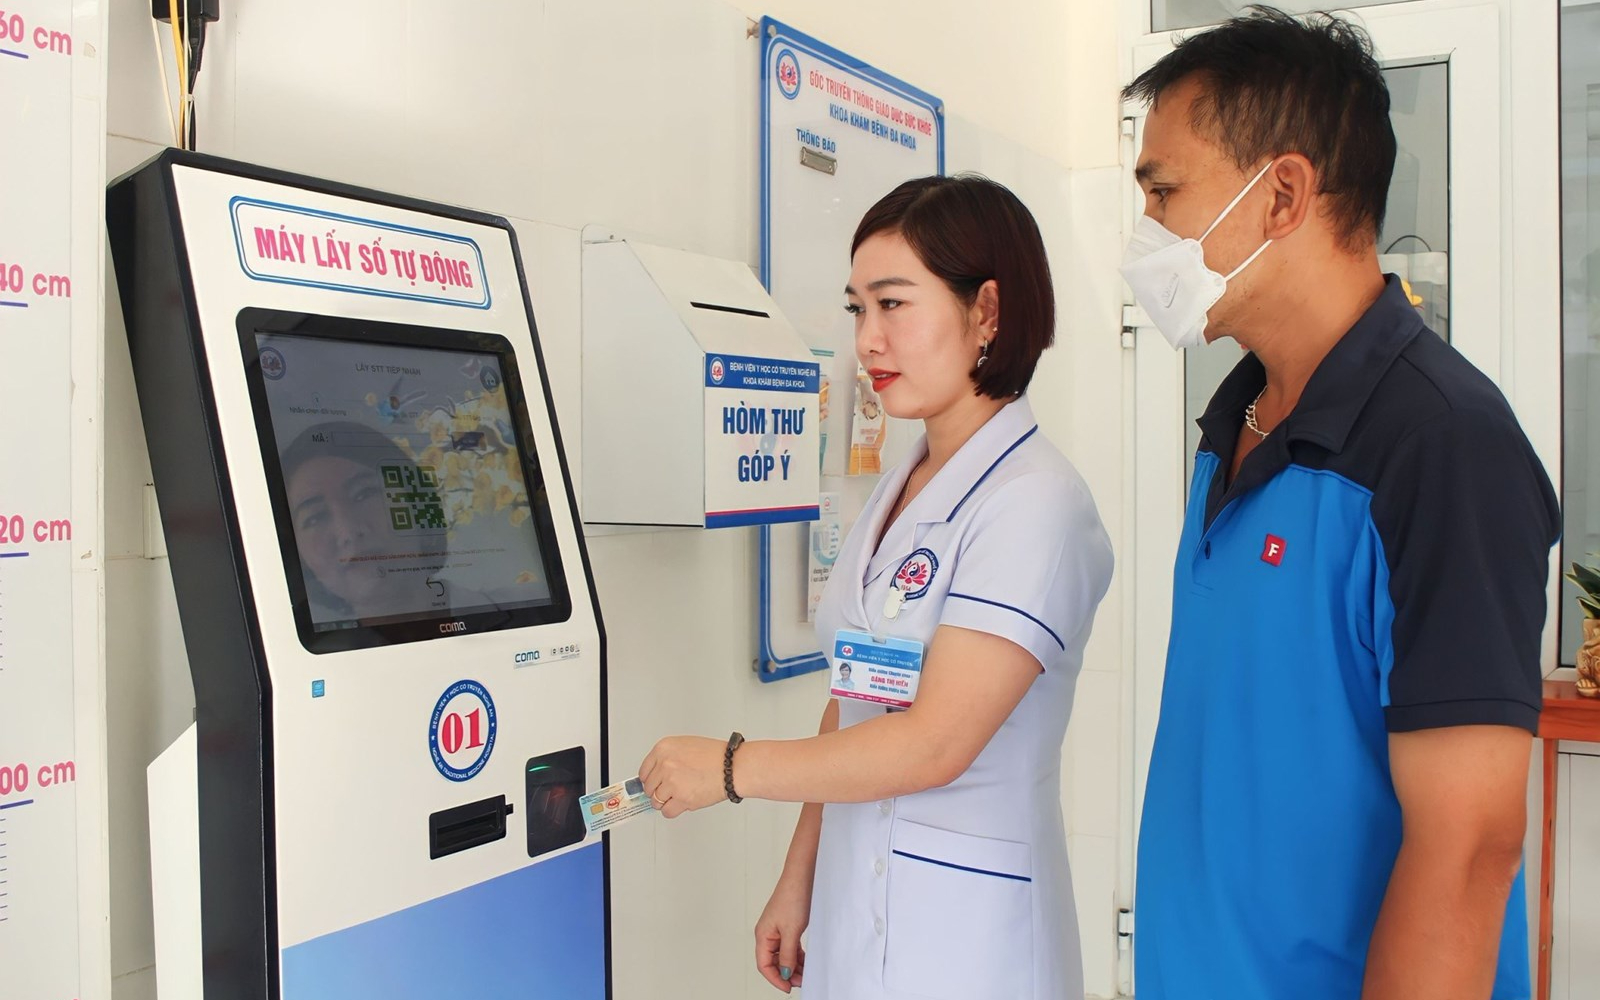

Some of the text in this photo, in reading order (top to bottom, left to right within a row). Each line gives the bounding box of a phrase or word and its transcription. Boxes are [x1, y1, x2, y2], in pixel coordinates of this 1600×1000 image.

[33, 27, 72, 55] cm
[797, 128, 836, 154] THÔNG BÁO
[830, 103, 848, 123] KHOA
[901, 132, 916, 151] KHOA
[254, 224, 474, 291] MÁY LẤY SỐ TỰ ĐỘNG
[33, 273, 70, 297] cm
[723, 401, 806, 435] HÒM THƯ
[738, 450, 791, 482] GÓP Ý
[33, 520, 71, 542] cm
[1268, 543, 1280, 556] F
[442, 708, 484, 754] 01
[38, 761, 75, 787] cm
